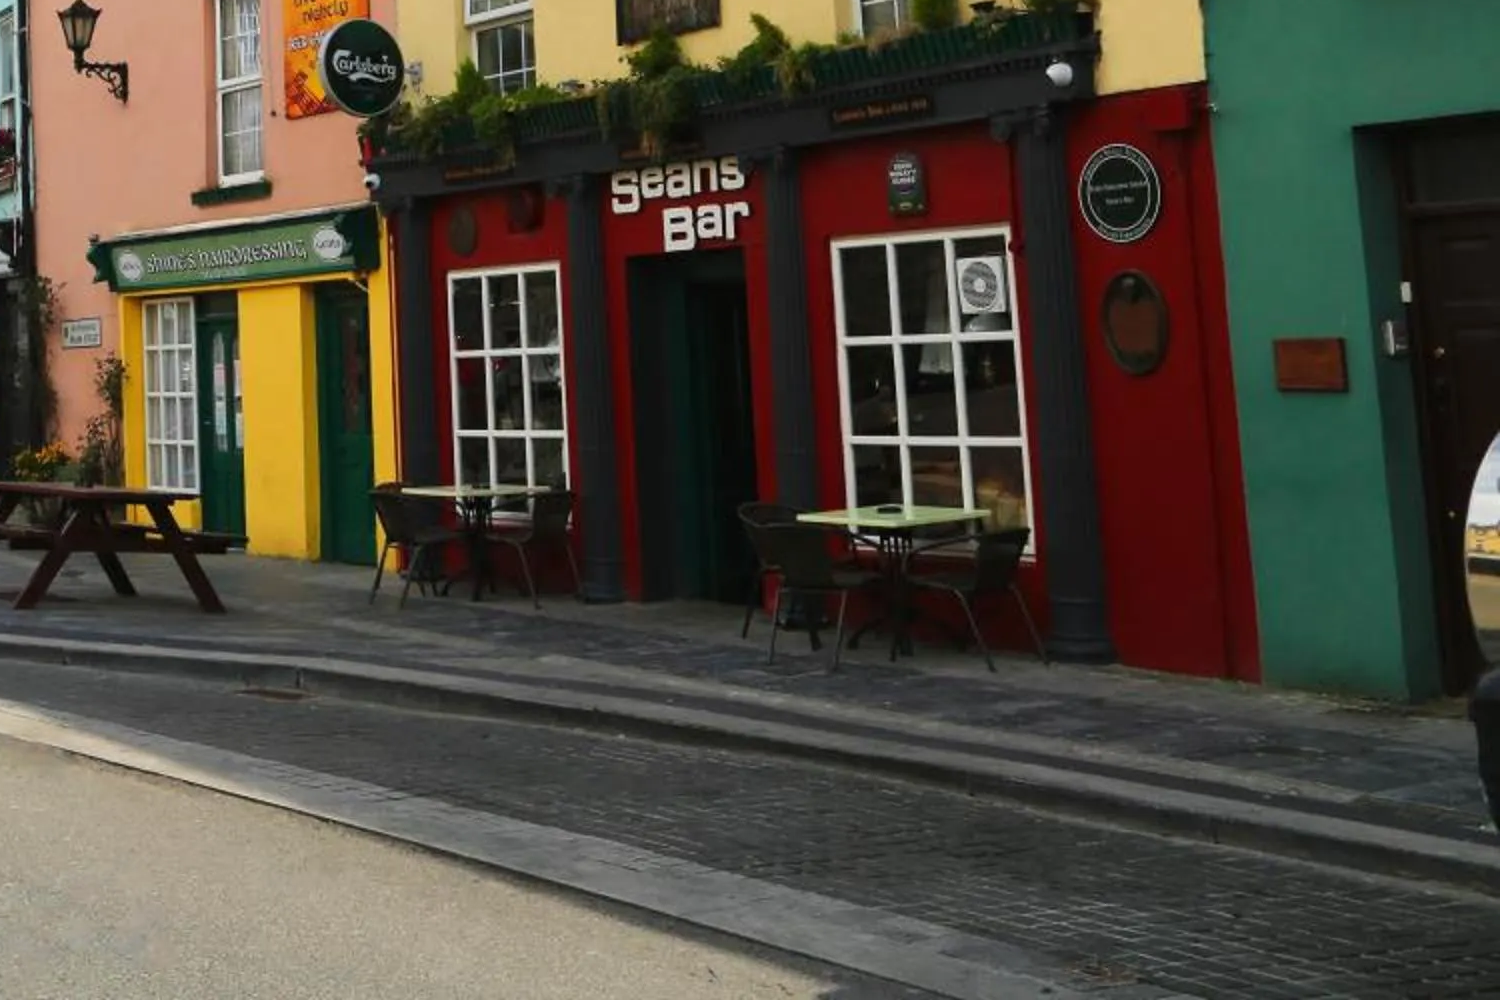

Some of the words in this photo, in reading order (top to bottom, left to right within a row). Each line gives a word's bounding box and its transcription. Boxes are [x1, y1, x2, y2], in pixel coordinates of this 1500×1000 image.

[333, 49, 397, 82] Carlsberg
[611, 155, 745, 214] Seans
[662, 201, 750, 252] Bar
